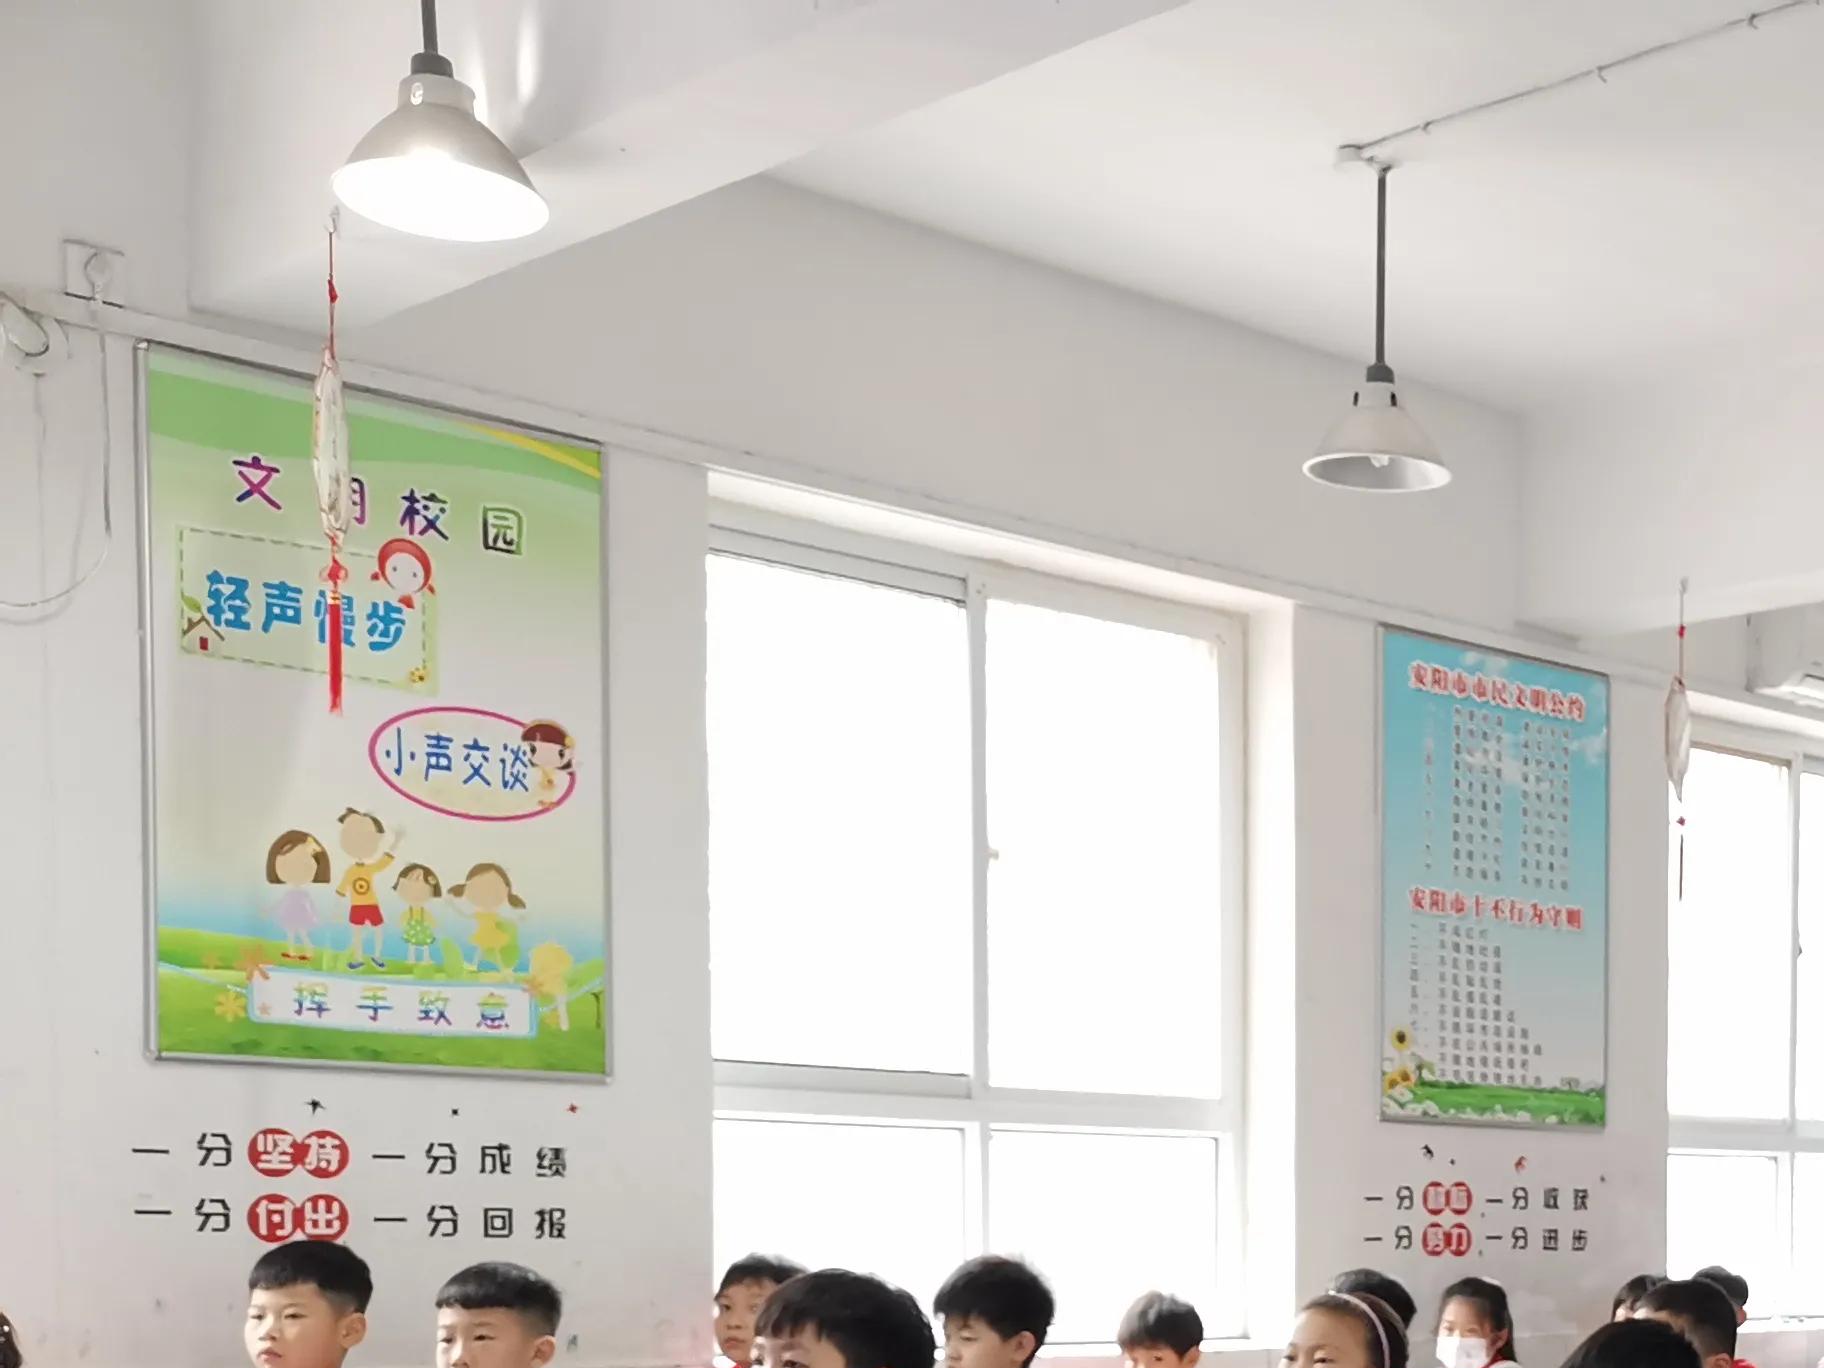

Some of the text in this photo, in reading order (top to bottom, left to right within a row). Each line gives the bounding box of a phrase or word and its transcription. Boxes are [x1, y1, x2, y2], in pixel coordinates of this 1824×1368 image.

[206, 568, 408, 654] 轻声慢步
[385, 727, 532, 792] 小声交谈
[293, 983, 510, 1031] 挥手致意
